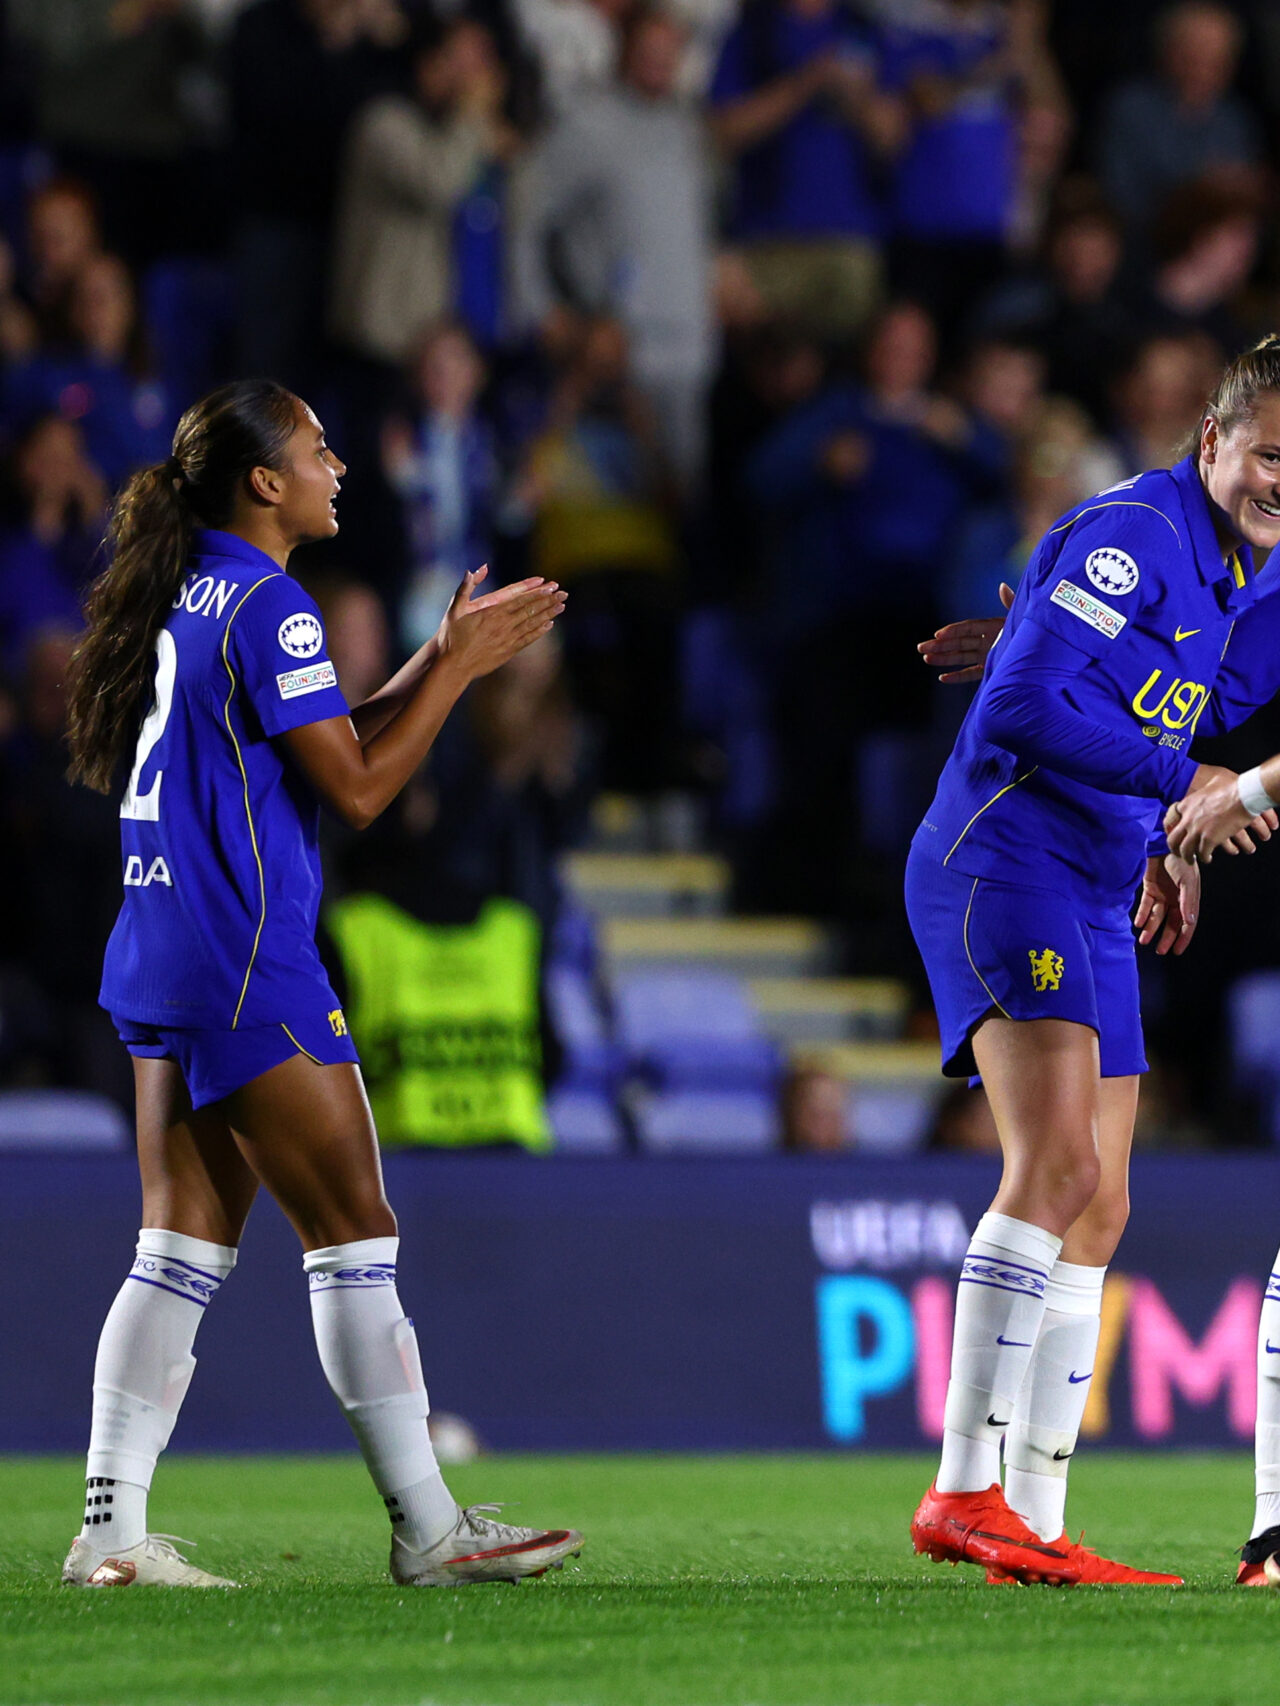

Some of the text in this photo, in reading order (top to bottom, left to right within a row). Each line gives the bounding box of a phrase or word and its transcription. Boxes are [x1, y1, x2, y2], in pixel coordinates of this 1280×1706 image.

[1056, 586, 1121, 632] FOUNDATION
[281, 669, 334, 691] FOUNDATION
[119, 627, 178, 821] 2
[123, 855, 173, 887] DA
